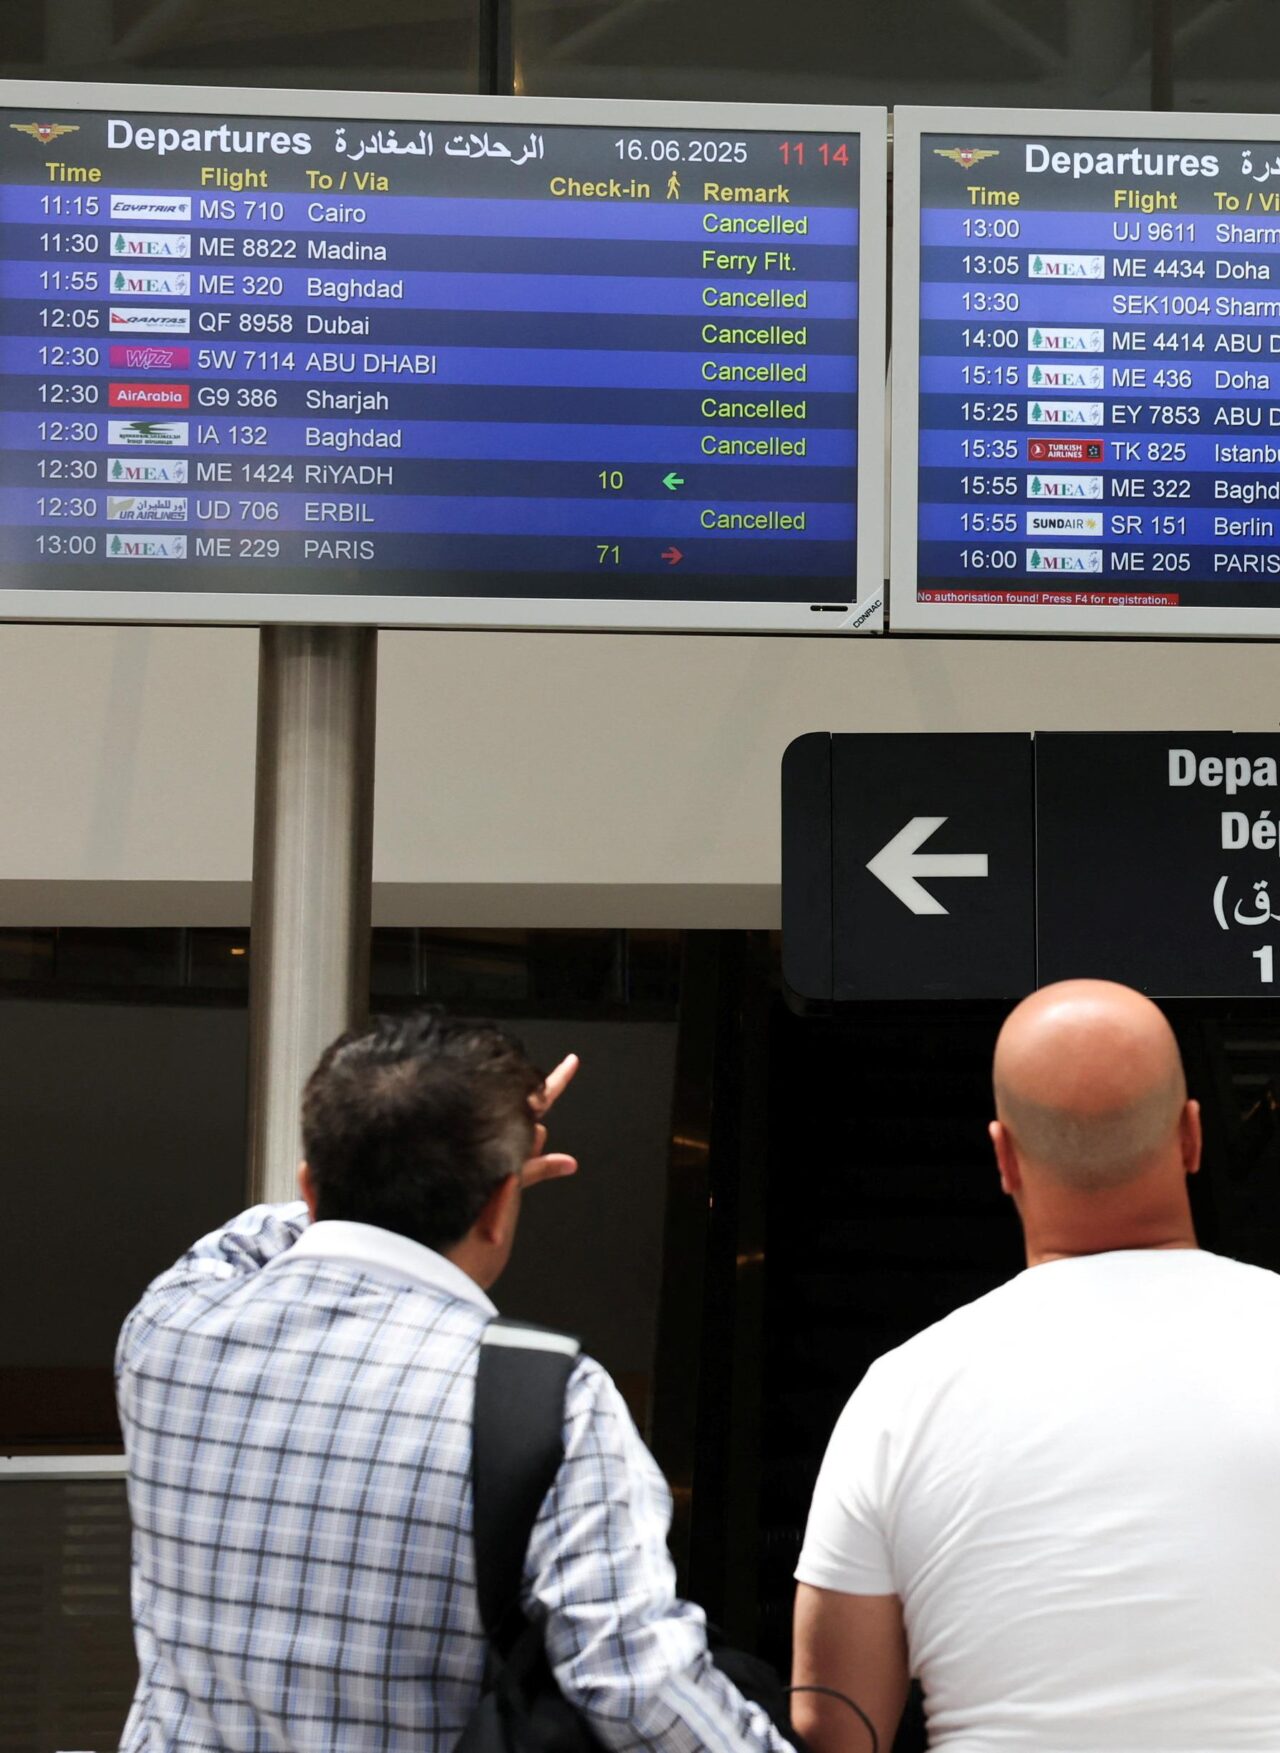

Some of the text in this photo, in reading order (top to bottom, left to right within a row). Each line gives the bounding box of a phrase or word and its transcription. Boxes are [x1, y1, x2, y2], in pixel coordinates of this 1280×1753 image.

[106, 119, 312, 156] Departures
[335, 127, 545, 166] الرحلات المغادرة
[614, 138, 748, 163] 16.06.2025
[779, 141, 849, 166] 11 14
[1025, 143, 1220, 179] Departures
[45, 162, 790, 203] Time Flight To / Via Check-in Remark
[966, 186, 1020, 206] Time
[1114, 189, 1178, 214] Flight
[1213, 191, 1240, 211] To
[1245, 192, 1253, 211] /
[40, 195, 807, 234] 11:15 EGYPTAIR MS 710 Cairo Cancelled
[962, 218, 1020, 238] 13:00
[1113, 221, 1140, 241] UJ
[1147, 222, 1194, 242] 9611
[40, 232, 796, 275] 11:30 MEA ME 8822 Madina Ferry Flt.
[962, 255, 1019, 275] 13:05
[1045, 263, 1087, 276] MEA
[1113, 258, 1147, 277] ME
[1153, 259, 1206, 279] 4434
[1215, 260, 1270, 280] Doha
[962, 291, 1019, 311] 13:30
[1112, 294, 1211, 315] SEK1004
[39, 308, 807, 345] 12:05 QANTAS QF 8958 Dubai Cancelled
[38, 383, 806, 419] 12:30 AirArabia G9 386 Sharjah Cancelled
[961, 439, 1018, 459] 15:35
[1110, 441, 1141, 461] TK
[1147, 442, 1186, 461] 825
[1048, 444, 1083, 452] TURKISH
[1048, 450, 1083, 459] AIRLINES
[36, 497, 805, 530] 12:30 UD 706 ERBIL Cancelled
[119, 511, 186, 521] UR AIRLINES
[960, 512, 1273, 536] 15:55 SUNDAIR SR 151 Berlin
[917, 592, 1178, 607] No authorisation found! Press F4 for registration...
[853, 600, 882, 628] CONRAC
[1252, 945, 1274, 983] 1
